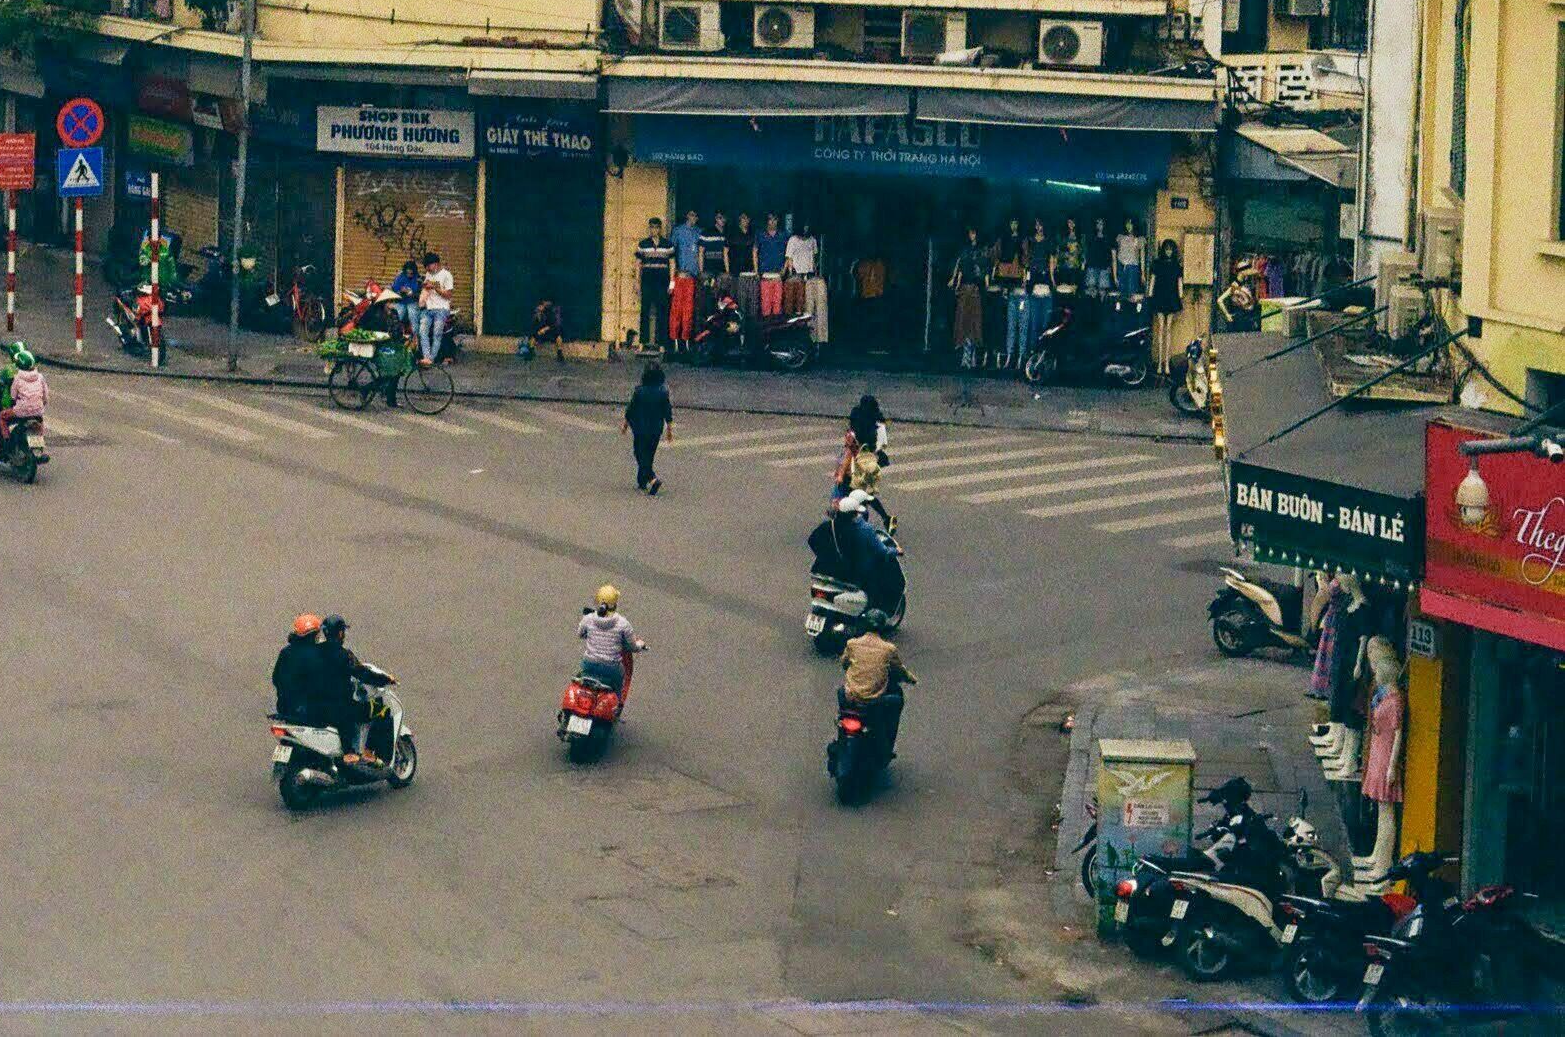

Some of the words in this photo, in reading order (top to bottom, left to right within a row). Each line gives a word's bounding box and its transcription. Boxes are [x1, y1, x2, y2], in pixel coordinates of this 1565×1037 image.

[359, 110, 398, 124] SHOP
[402, 112, 430, 124] SILK
[331, 124, 398, 141] PHƯƠNG
[403, 127, 460, 144] HƯƠNG
[552, 132, 592, 150] THAO
[814, 147, 850, 160] CÔNG
[853, 149, 866, 161] TY
[899, 151, 937, 164] TRANG
[959, 153, 981, 168] NỘI
[1237, 482, 1274, 512] BÁN
[1277, 492, 1324, 524] BUÔN
[1339, 505, 1376, 537] BÁN
[1380, 512, 1405, 543] LẺ
[1412, 625, 1434, 642] 113
